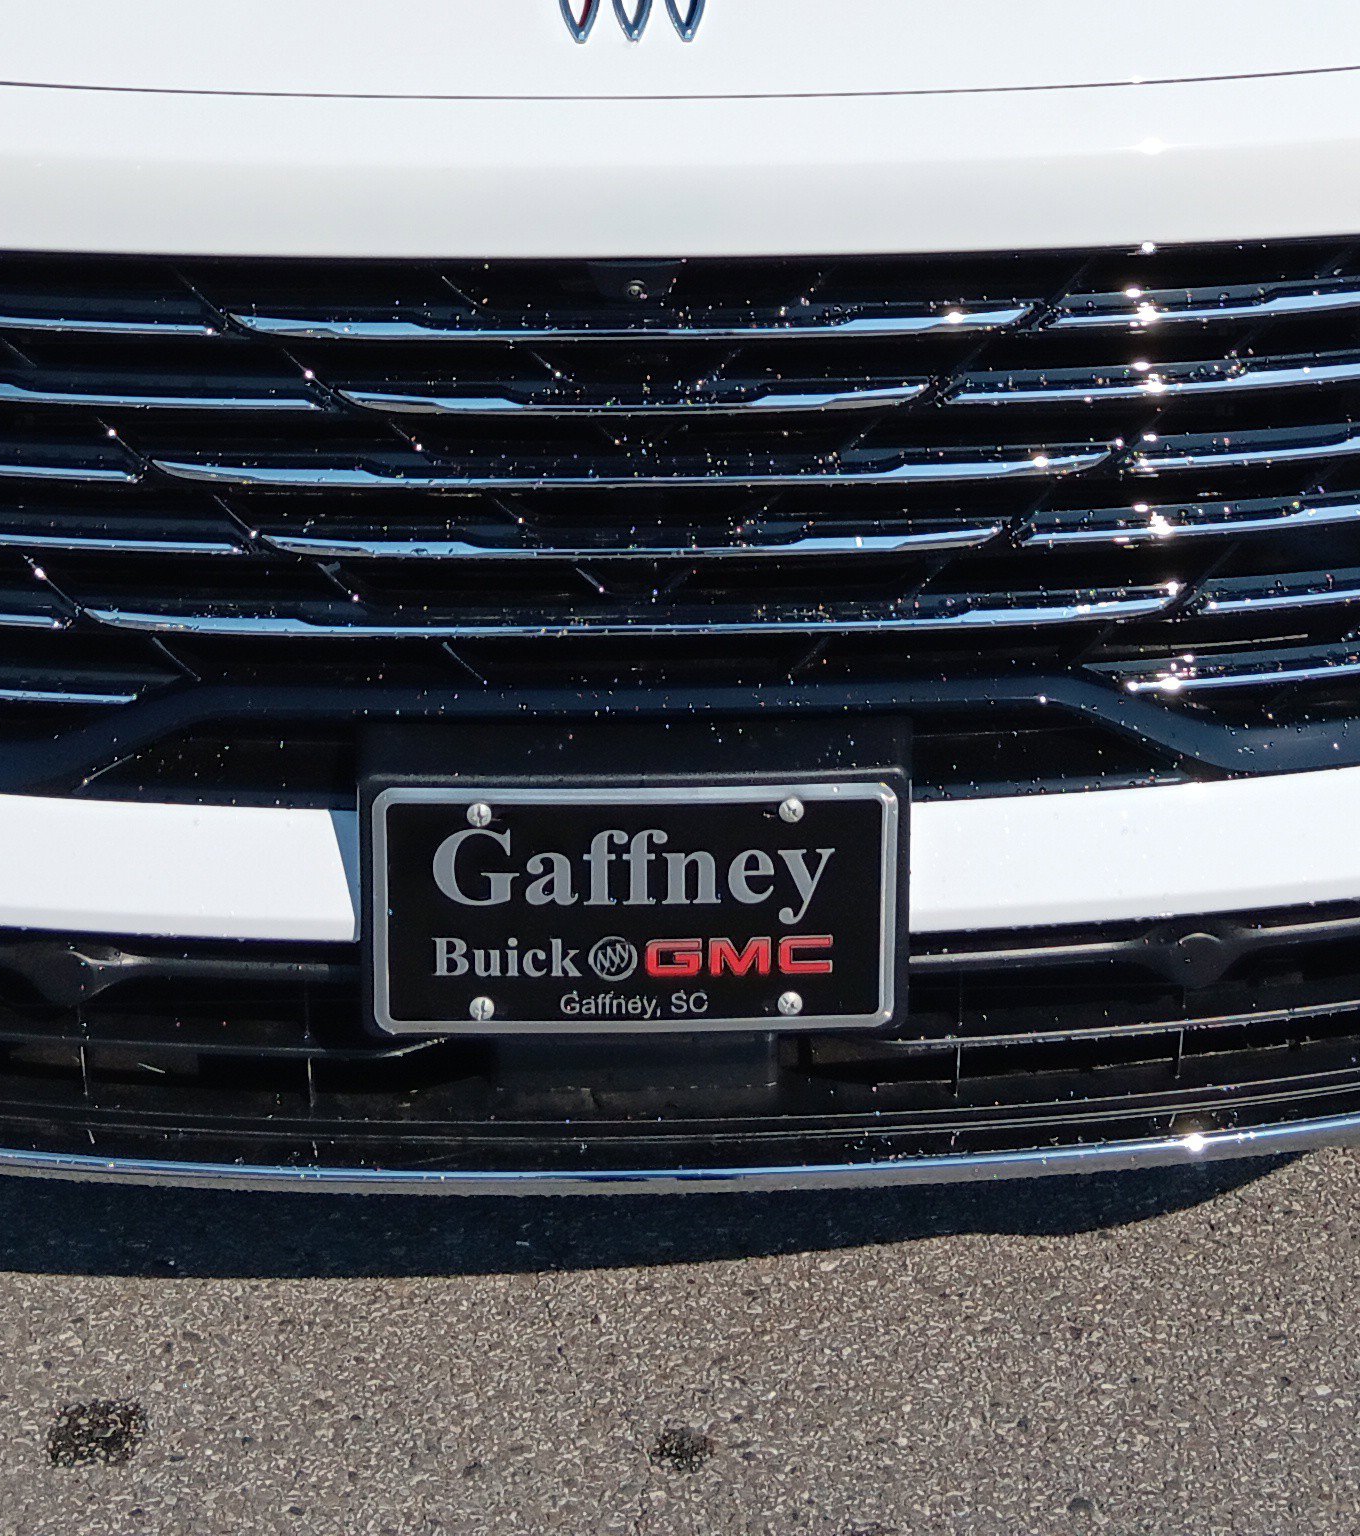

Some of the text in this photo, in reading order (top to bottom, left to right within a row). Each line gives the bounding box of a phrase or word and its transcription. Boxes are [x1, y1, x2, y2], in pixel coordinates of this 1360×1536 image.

[432, 827, 836, 926] Gaffney
[431, 934, 835, 979] Buick GMC
[560, 992, 709, 1019] Gaffney, SC
